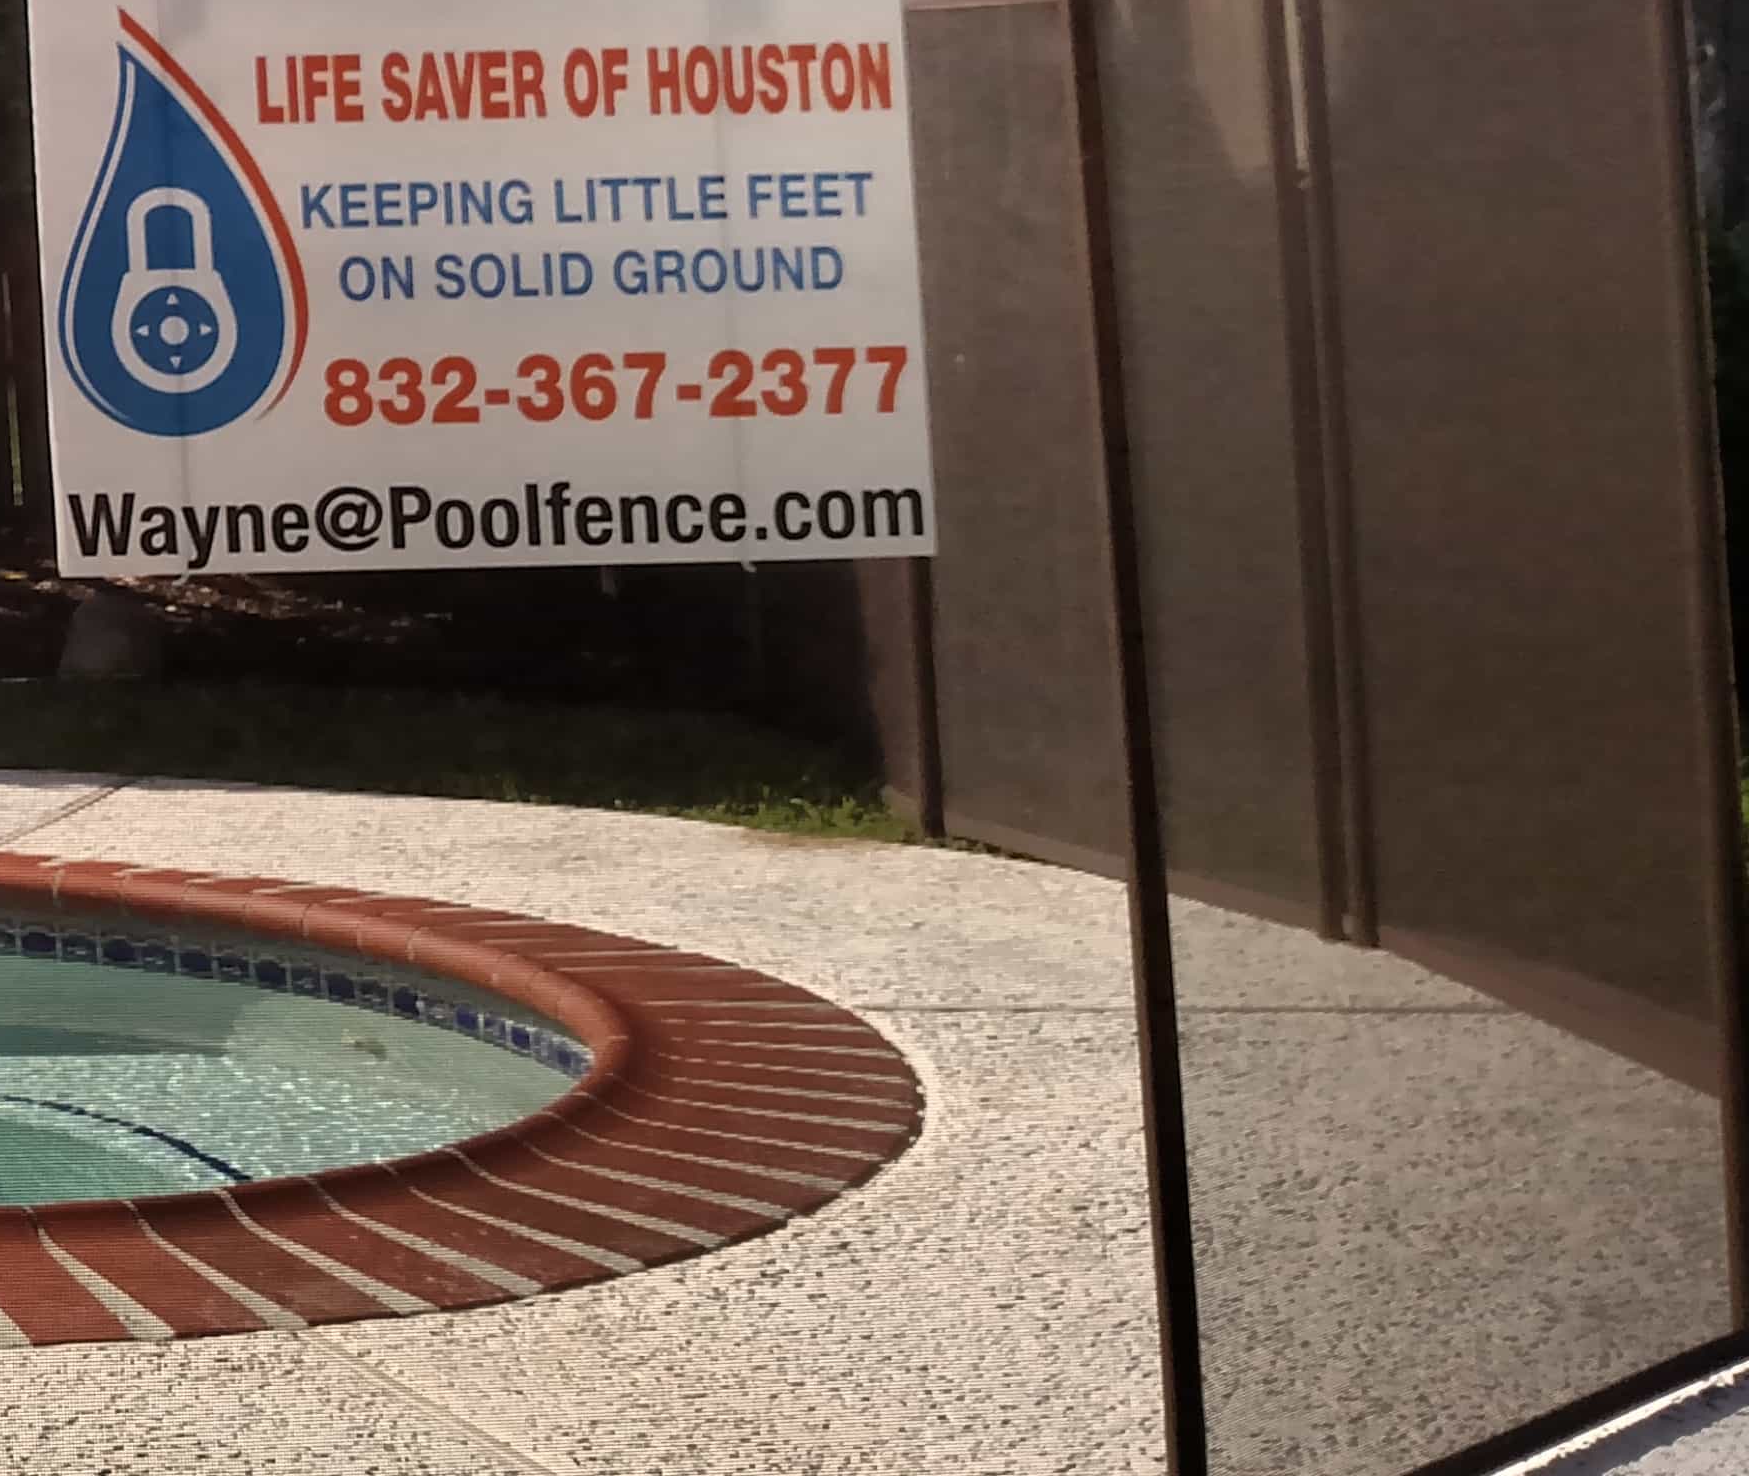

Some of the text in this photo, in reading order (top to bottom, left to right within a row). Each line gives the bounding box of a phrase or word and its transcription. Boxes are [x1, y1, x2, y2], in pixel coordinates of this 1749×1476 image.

[256, 43, 891, 123] LIFE SAVER OF HOUSTON
[302, 173, 872, 228] KEEPING LITTLE FEET
[340, 247, 842, 301] ON SOLID GROUND
[325, 347, 907, 426] 832-367-2377
[68, 483, 925, 567] Wayne@Poolfence.com
